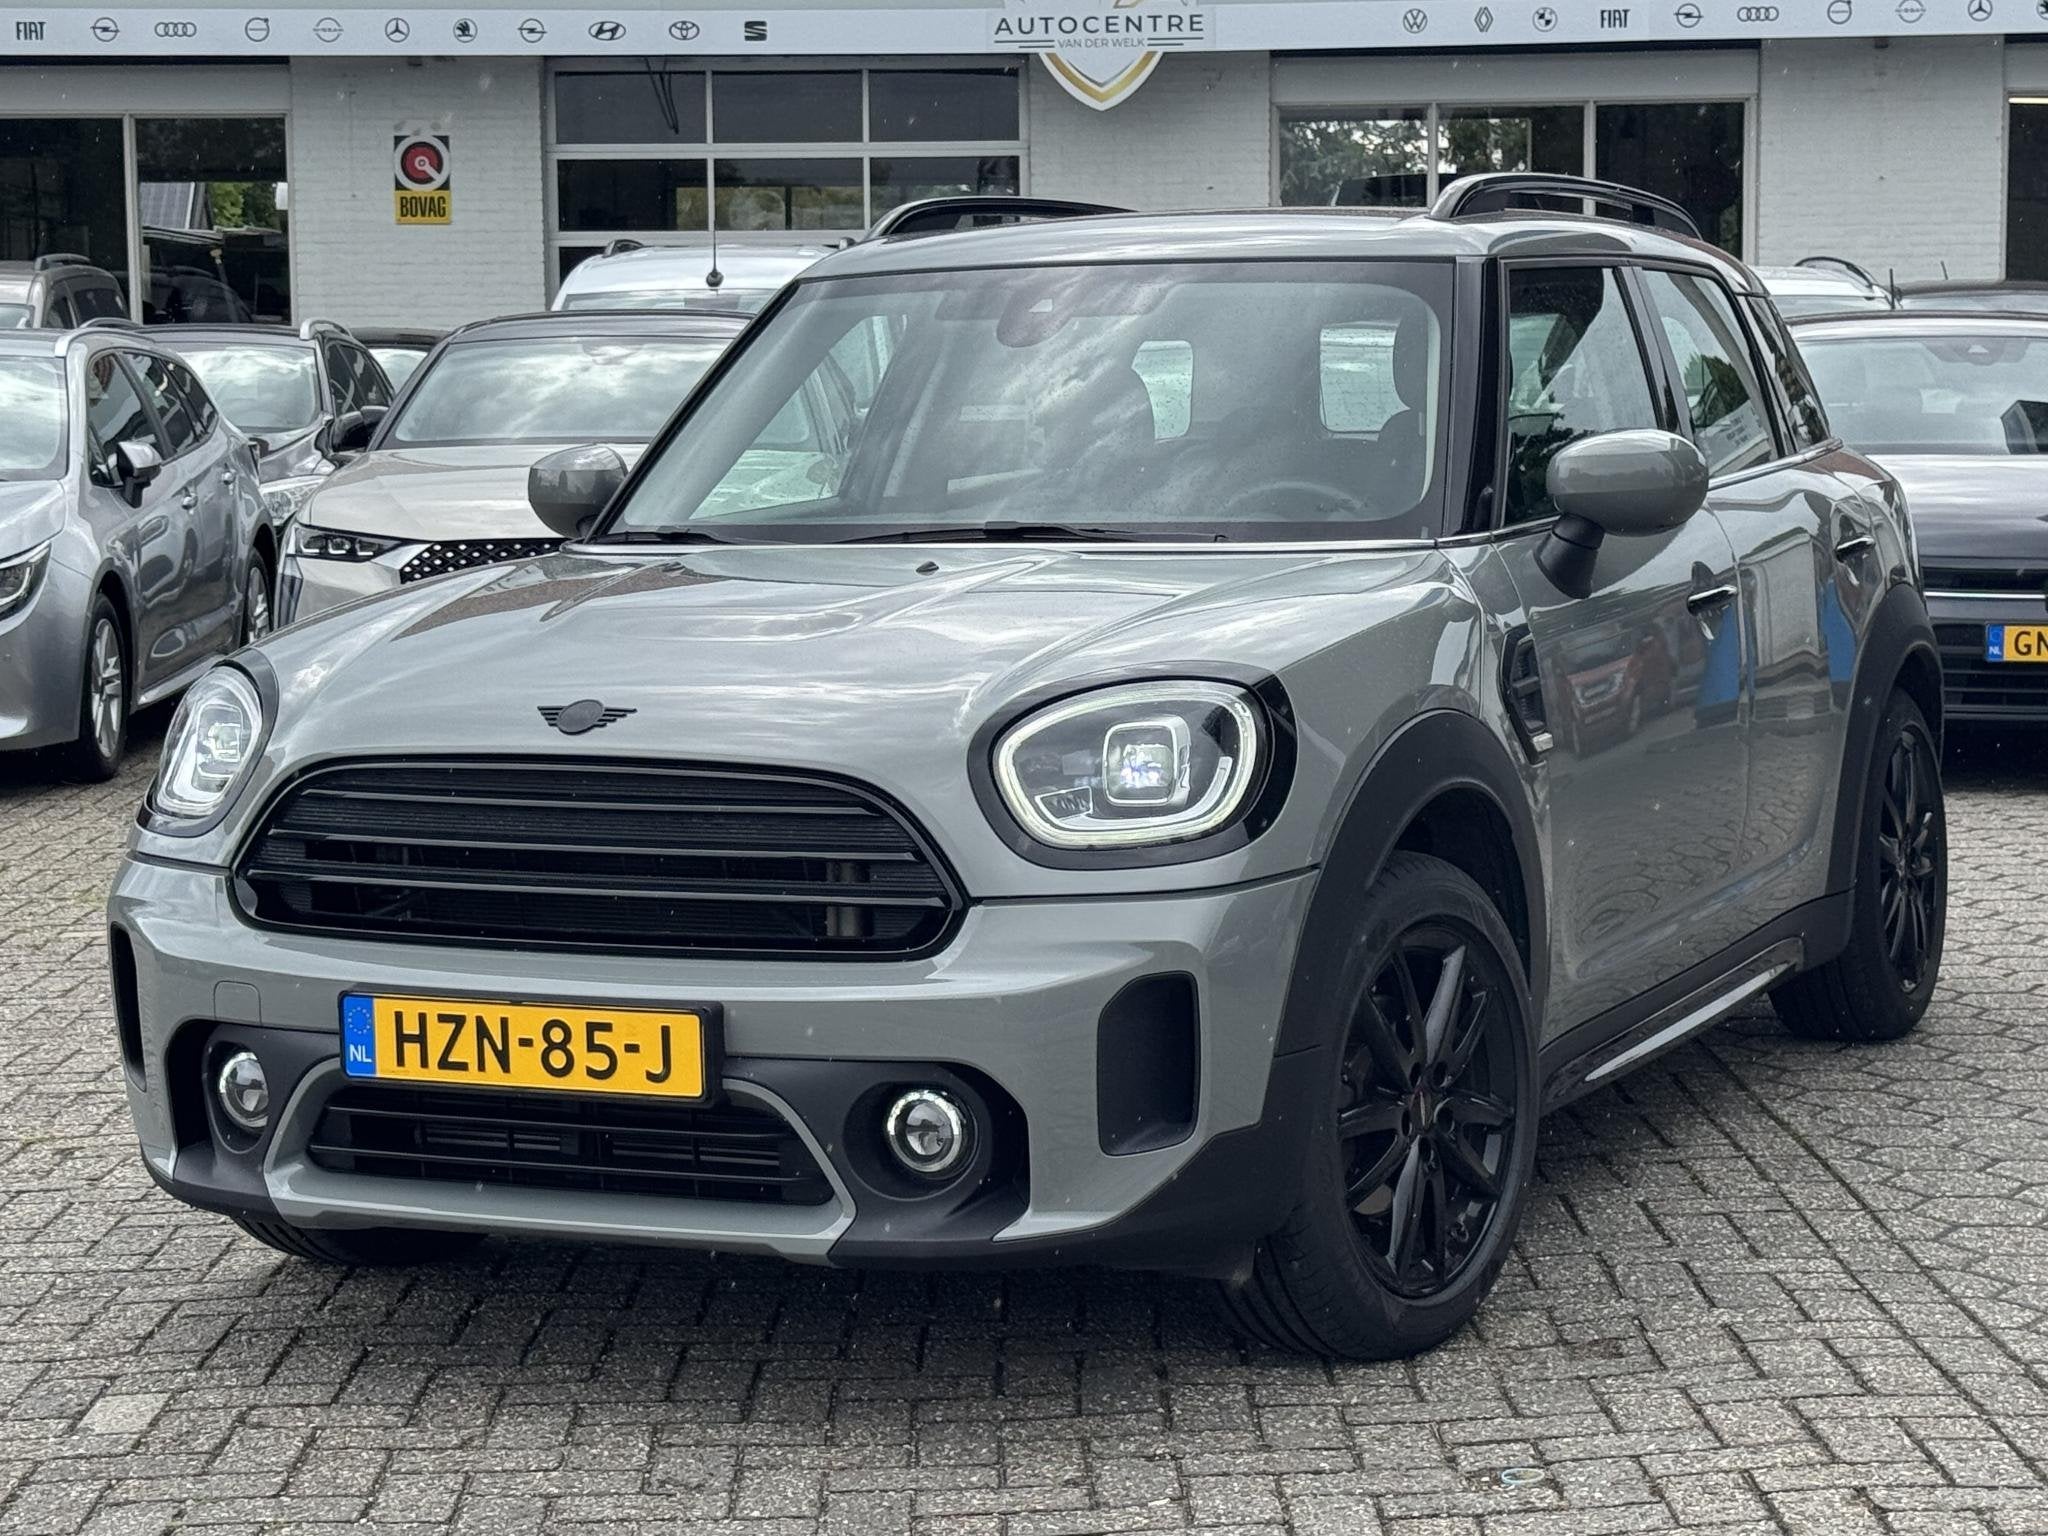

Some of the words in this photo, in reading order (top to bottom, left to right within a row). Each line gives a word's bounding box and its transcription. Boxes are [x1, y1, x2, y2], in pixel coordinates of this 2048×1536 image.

[994, 14, 1204, 35] AUTOCENTRE
[1600, 9, 1631, 29] FIAT
[16, 21, 46, 41] FIAT
[1057, 38, 1082, 49] VAN
[1084, 38, 1109, 48] DER
[1110, 37, 1146, 48] WELK
[400, 195, 447, 218] BOVAG
[1988, 646, 2002, 656] NL
[349, 1044, 372, 1063] NL
[393, 1010, 673, 1084] HZN-85-J
